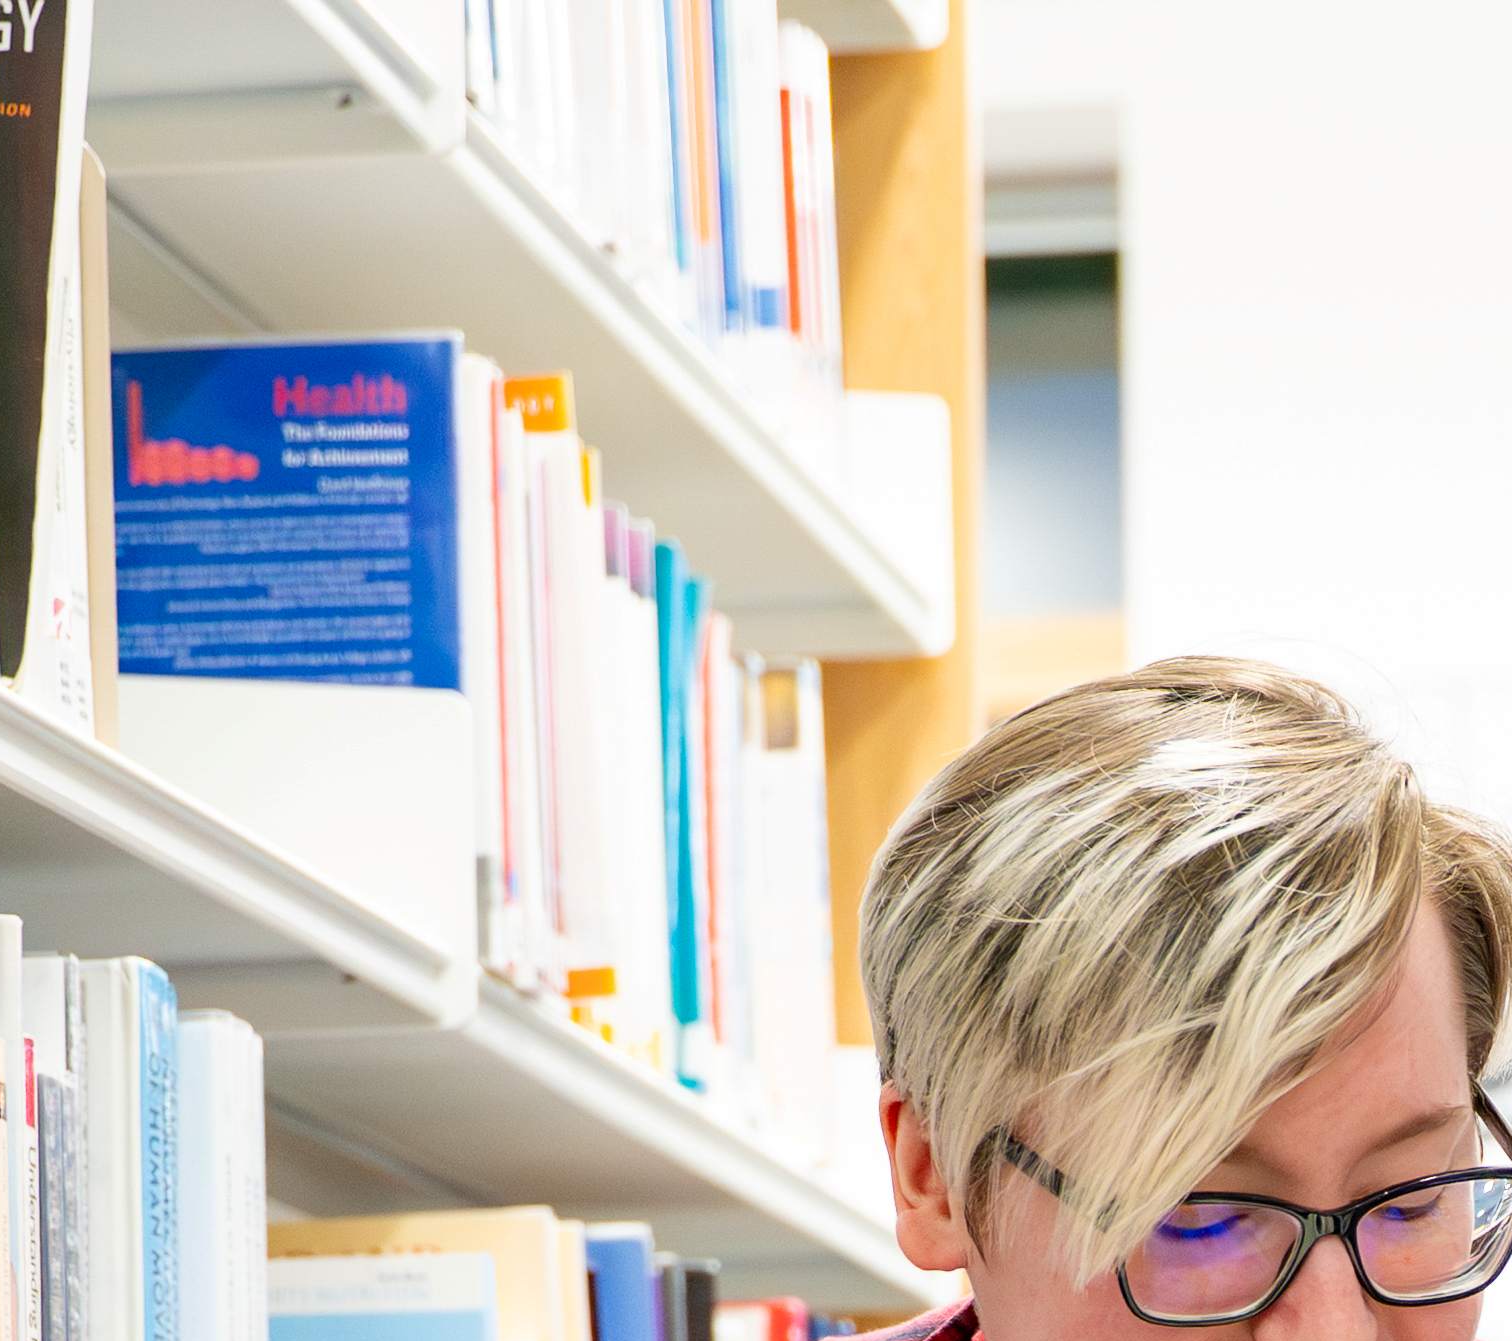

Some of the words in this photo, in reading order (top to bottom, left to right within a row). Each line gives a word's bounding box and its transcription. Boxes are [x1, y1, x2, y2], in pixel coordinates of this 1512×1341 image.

[273, 371, 407, 417] Health
[150, 1112, 165, 1237] HUMAN
[28, 1146, 39, 1329] Understanding
